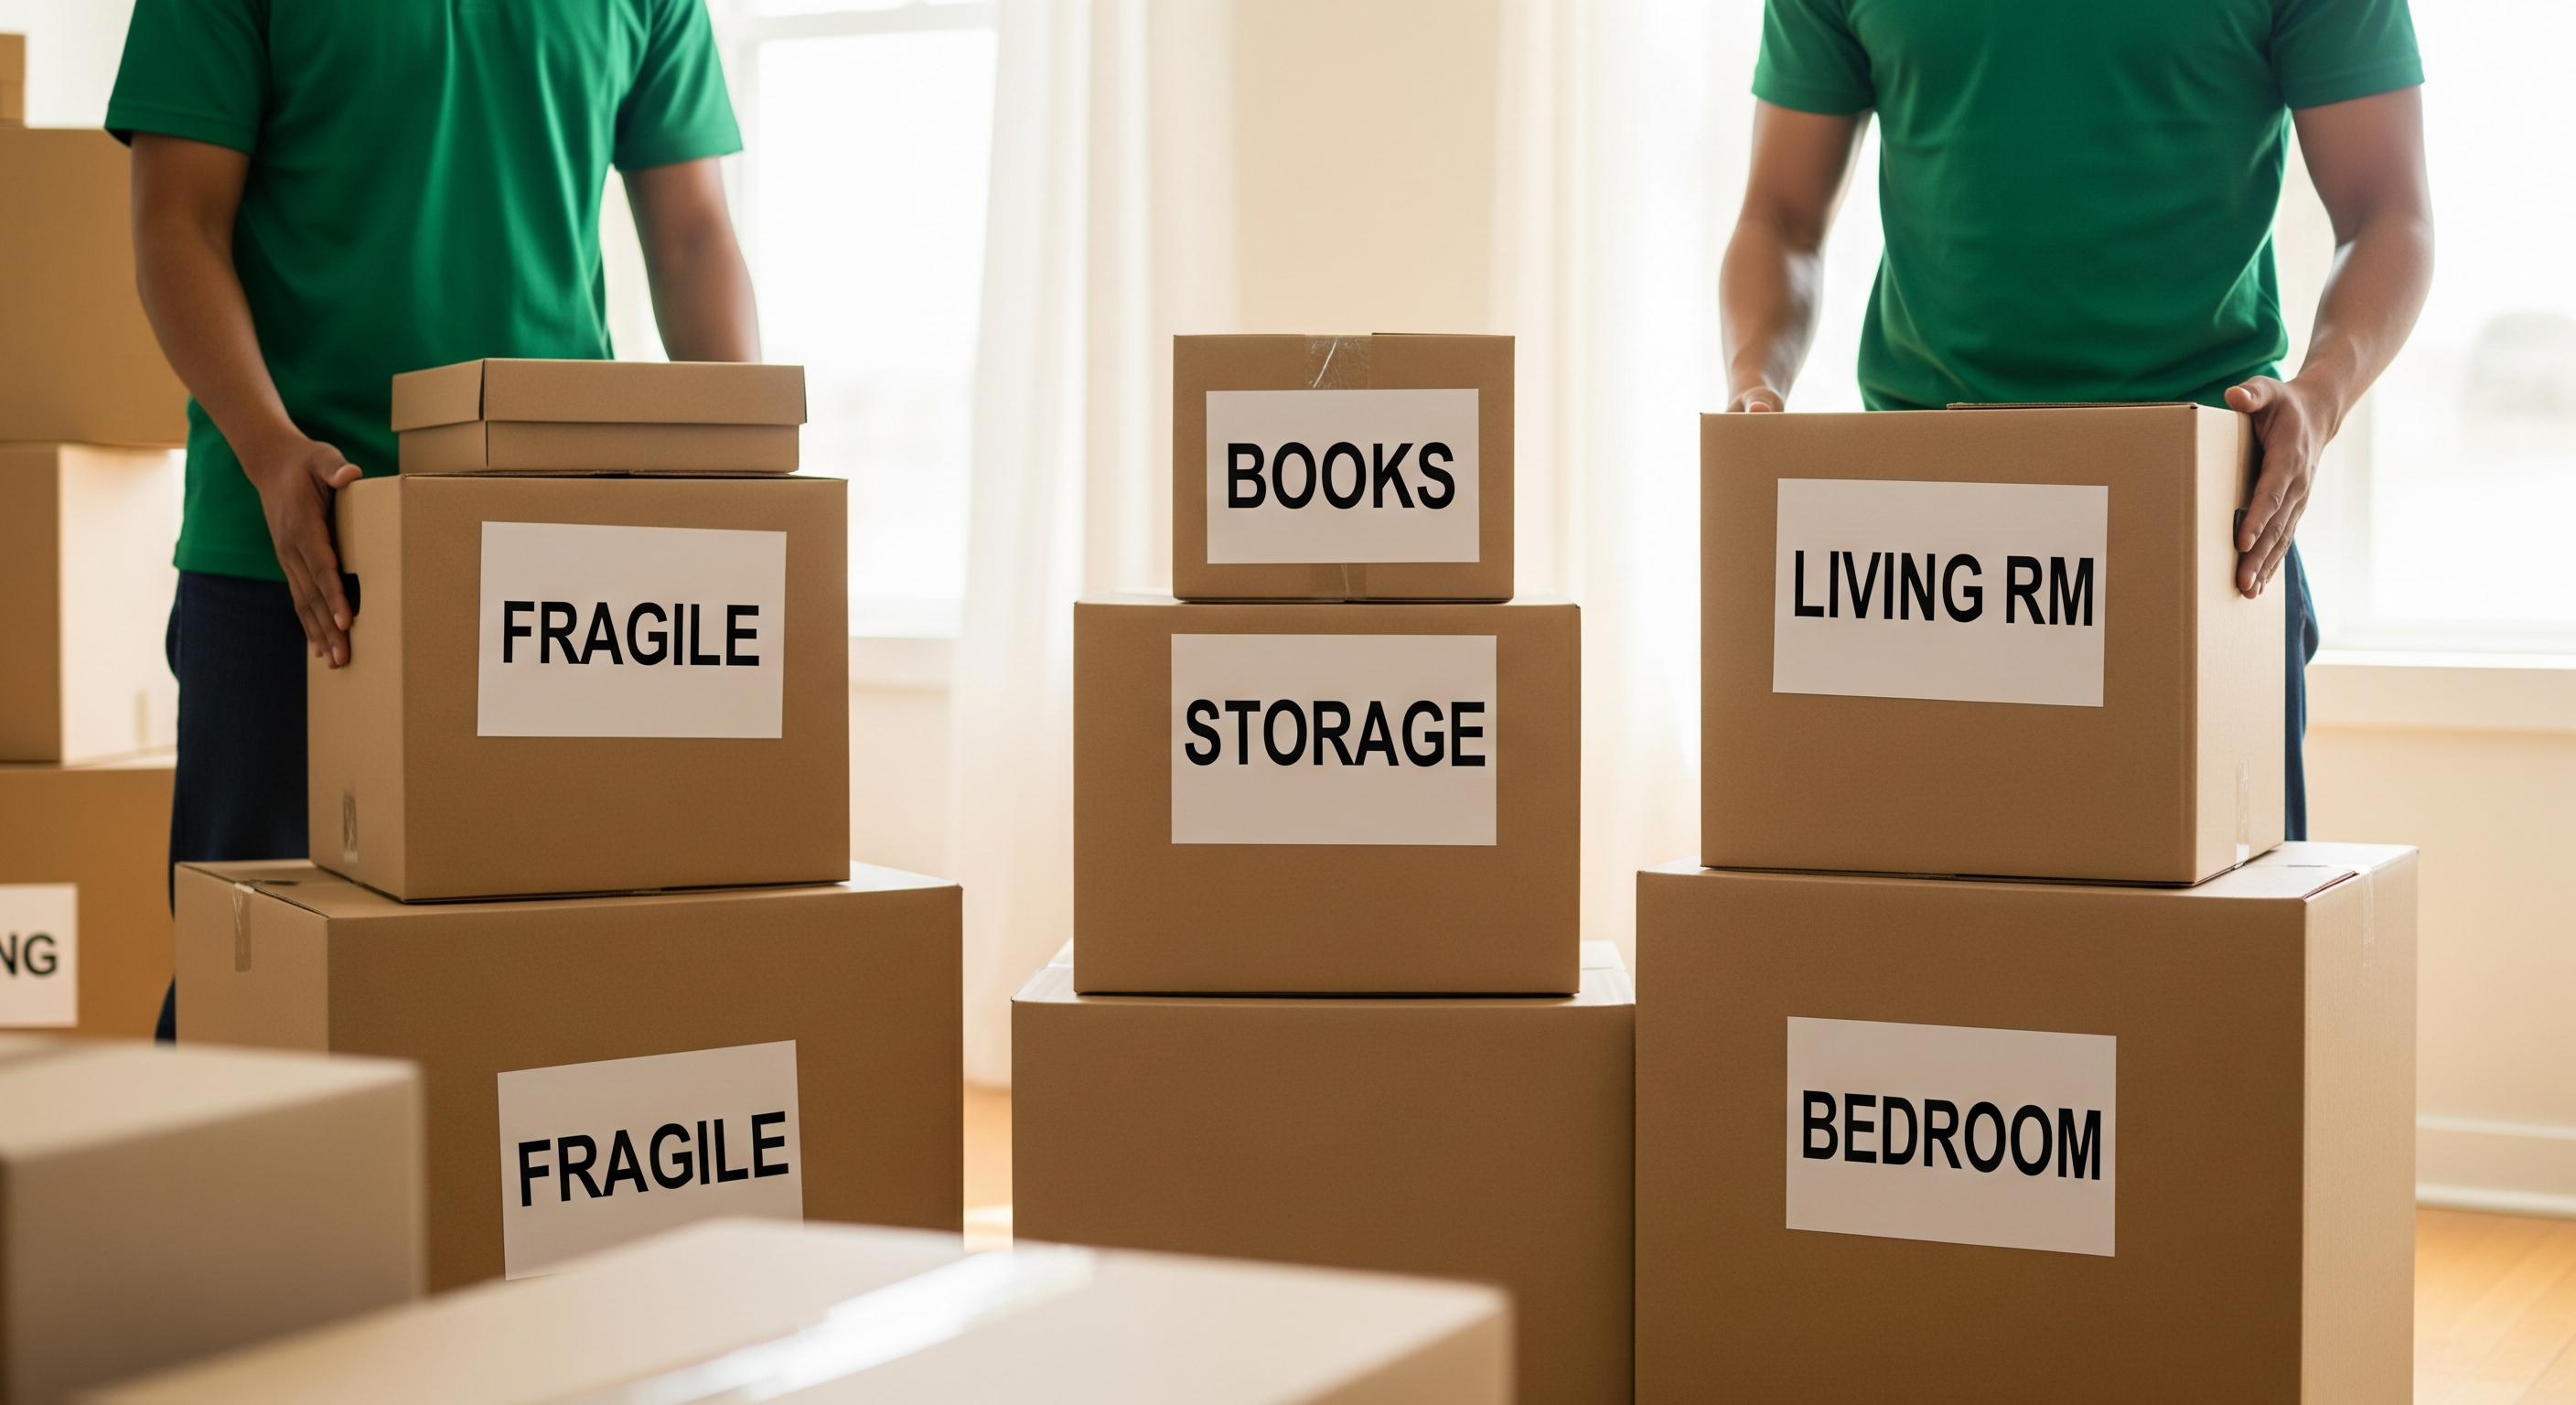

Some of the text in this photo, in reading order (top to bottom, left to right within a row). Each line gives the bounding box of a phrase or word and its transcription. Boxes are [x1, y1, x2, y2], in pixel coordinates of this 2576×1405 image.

[1227, 441, 1456, 510] BOOKS
[1793, 550, 2095, 627] LIVING RM
[501, 600, 761, 667] FRAGILE
[1183, 699, 1487, 767] STORAGE
[517, 1110, 790, 1207] FRAGILE
[1801, 1089, 2103, 1181] BEDROOM
